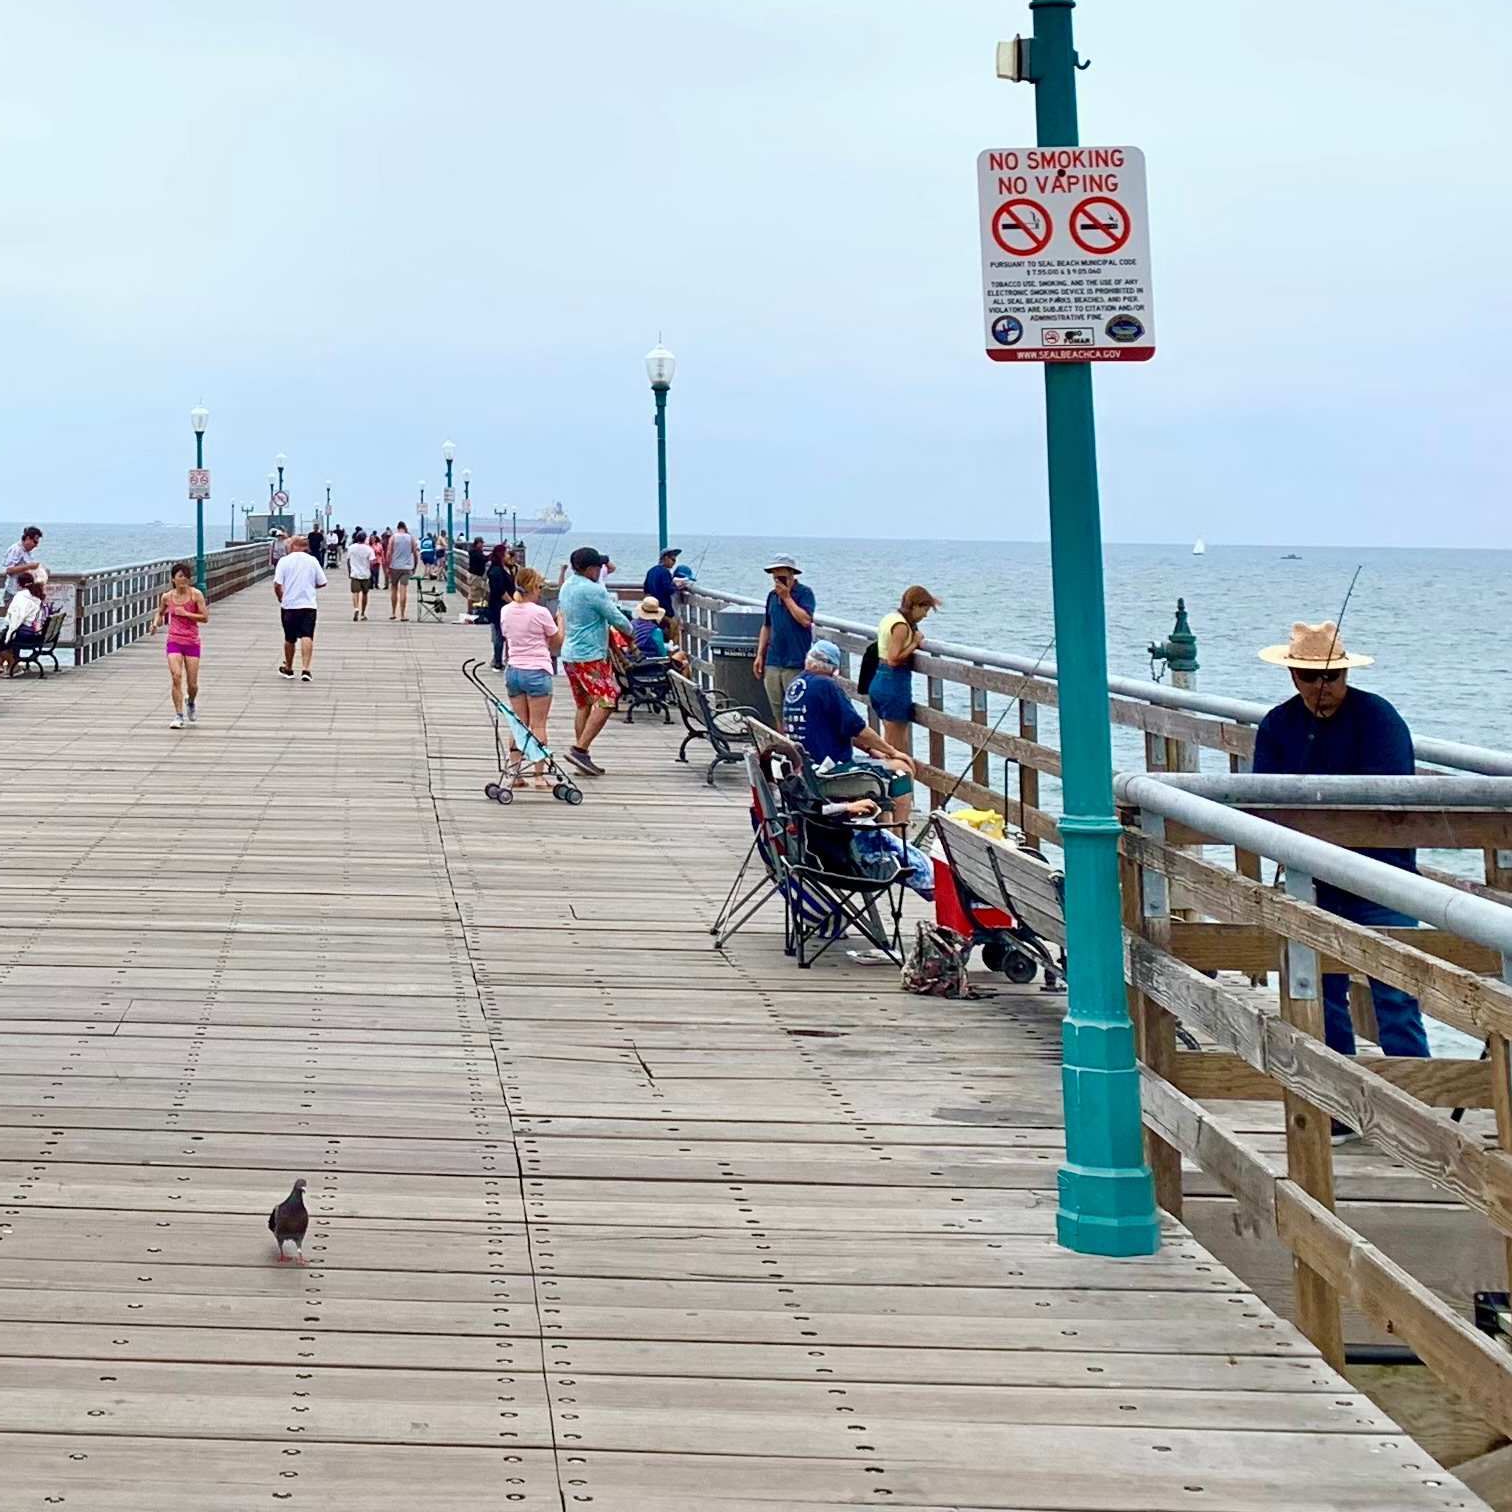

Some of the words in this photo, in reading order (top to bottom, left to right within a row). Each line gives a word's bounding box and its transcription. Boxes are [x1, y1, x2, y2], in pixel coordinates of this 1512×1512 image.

[990, 152, 1019, 171] NO
[1027, 149, 1124, 169] SMOKING
[998, 176, 1027, 195] NO
[1035, 174, 1119, 194] VAPING
